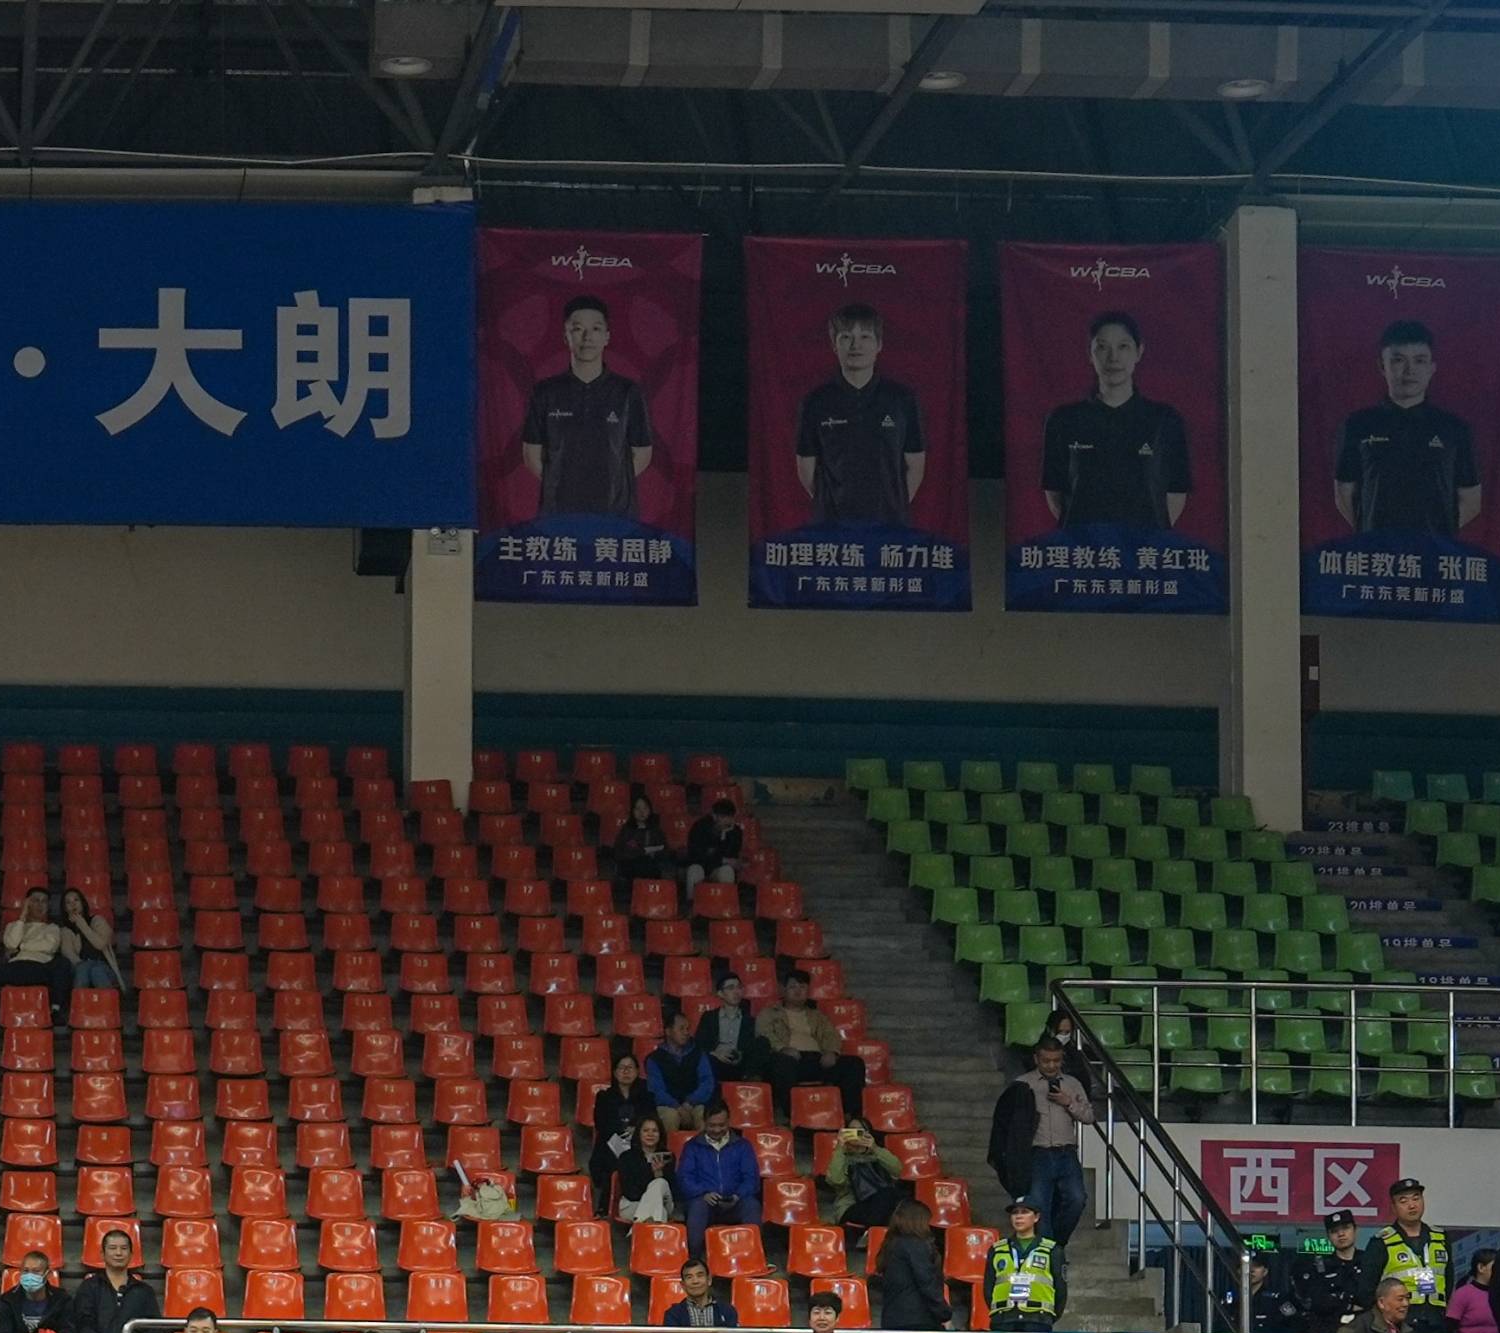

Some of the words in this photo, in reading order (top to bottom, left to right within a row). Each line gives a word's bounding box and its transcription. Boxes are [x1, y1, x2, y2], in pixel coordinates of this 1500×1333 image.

[498, 535, 576, 563] 主教练
[594, 536, 672, 564] 黄思静
[765, 541, 865, 568] 助理教练
[880, 541, 955, 570] 杨力维
[1019, 544, 1121, 571] 助理教练
[1318, 551, 1422, 580] 体能教练
[1224, 1147, 1379, 1217] 西区
